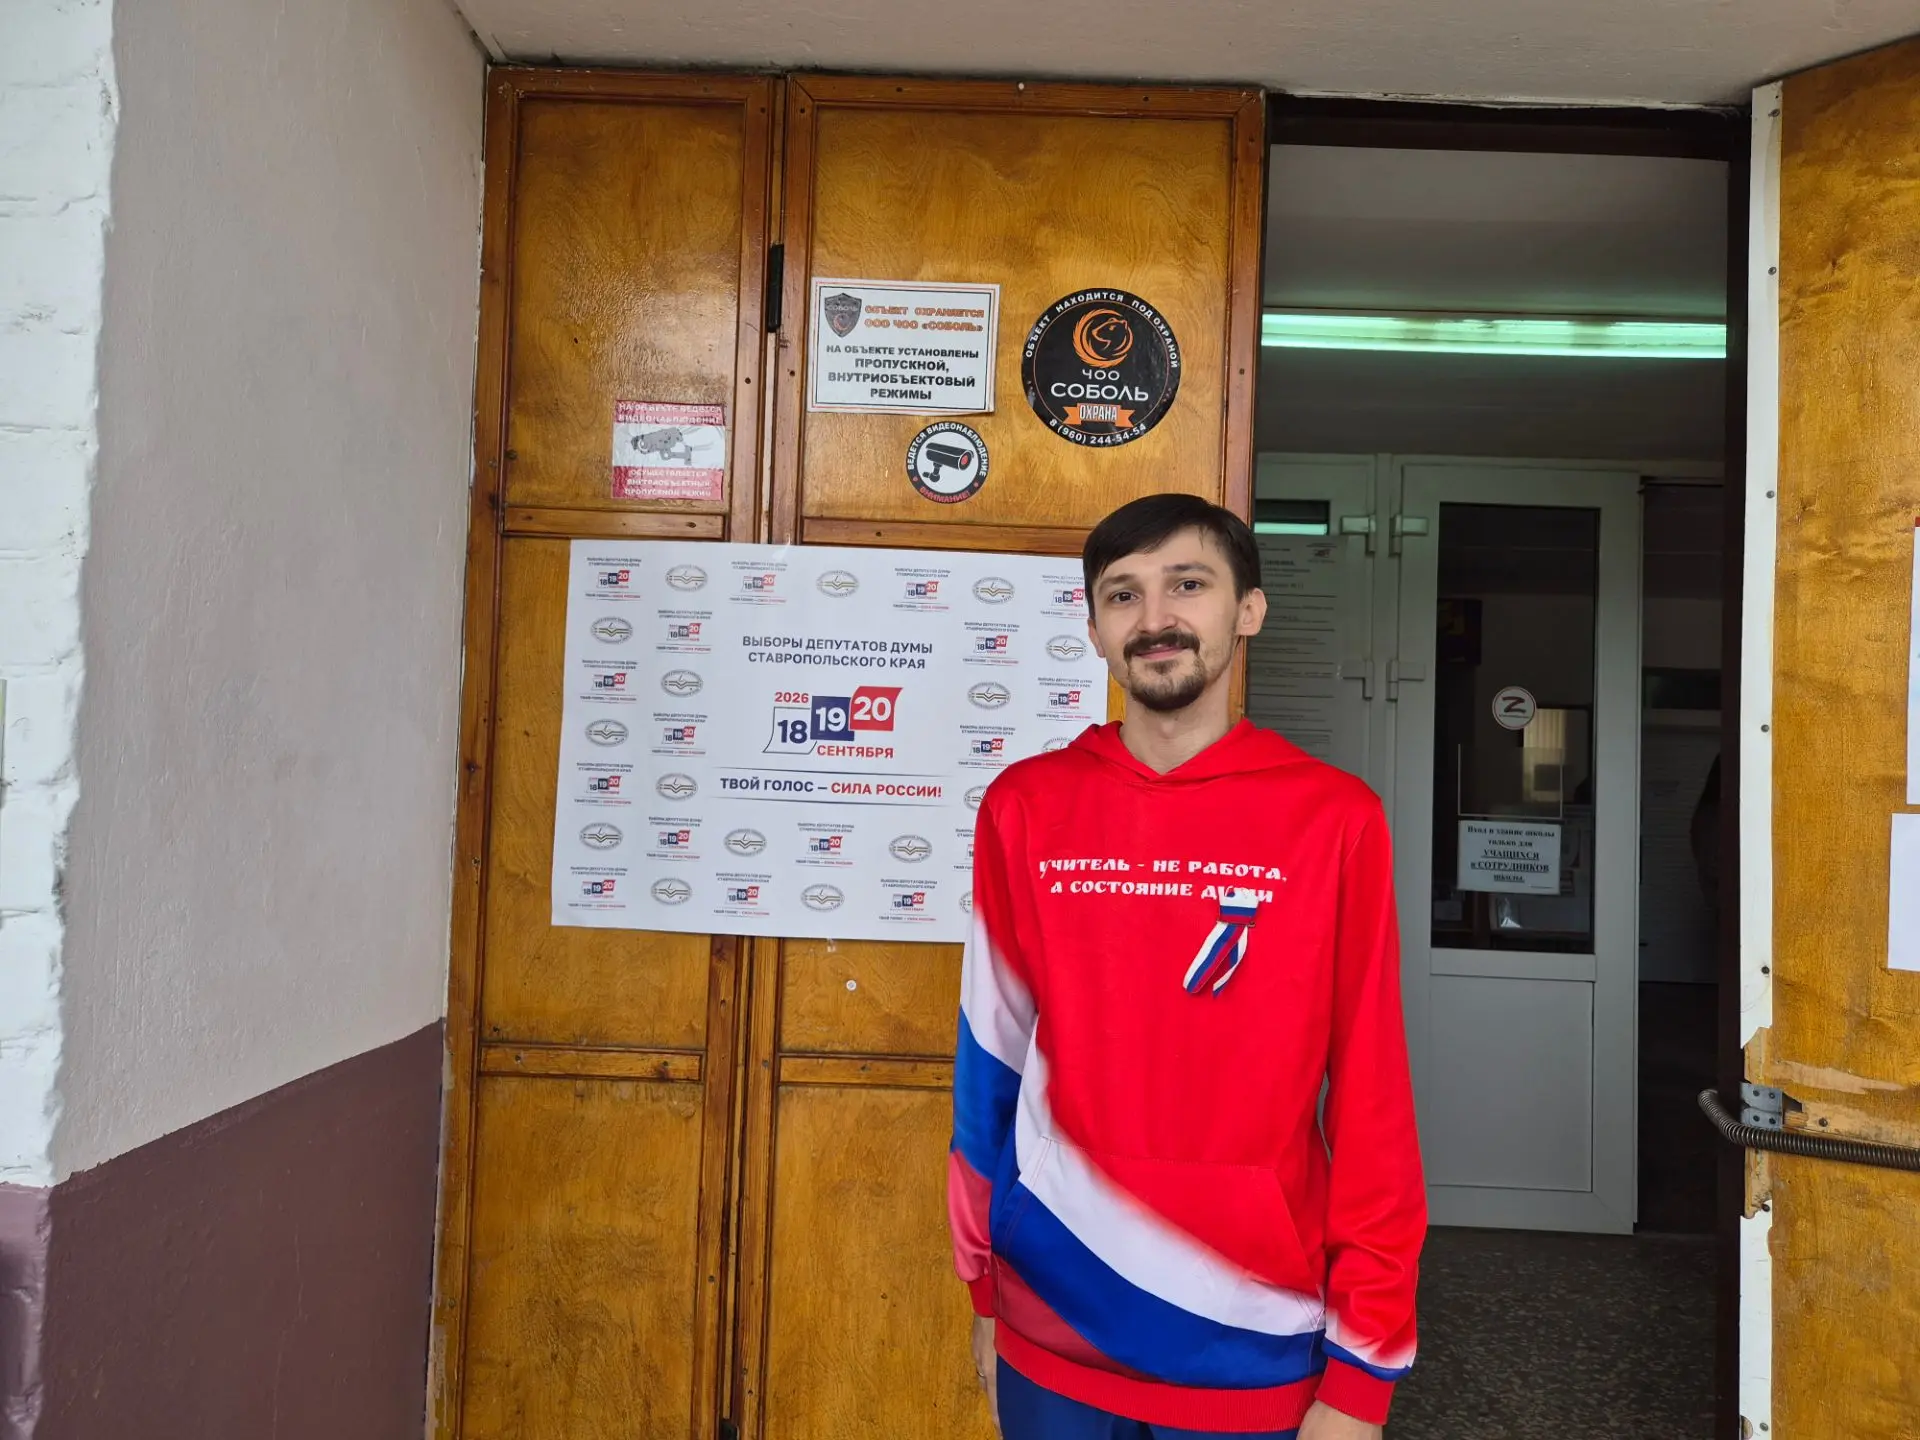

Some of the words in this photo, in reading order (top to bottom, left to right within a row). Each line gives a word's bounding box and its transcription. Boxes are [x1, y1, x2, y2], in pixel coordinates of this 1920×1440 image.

[865, 305, 908, 315] ОБЪЕКТ
[914, 307, 984, 318] ОХРАНЯЕТСЯ
[864, 319, 890, 328] ООО
[894, 320, 918, 329] ЧОО
[922, 322, 984, 332] «СОБОЛЬ»
[1026, 314, 1051, 358] ОБЪЕКТ
[1056, 292, 1124, 313] НАХОДИТСЯ
[1132, 300, 1154, 318] ПОД
[1154, 318, 1178, 368] ОХРАНОЙ
[826, 345, 842, 353] НА
[844, 346, 894, 355] ОБЪЕКТЕ
[898, 348, 979, 358] УСТАНОВЛЕНЫ
[855, 358, 950, 373] ПРОПУСКНОЙ,
[828, 372, 975, 387] ВНУТРИОБЪЕКТОВЫЙ
[1082, 369, 1120, 380] ЧОО
[870, 388, 932, 400] РЕЖИМЫ
[1051, 382, 1149, 402] СОБОЛЬ
[1080, 405, 1118, 421] ОХРАНА
[1050, 418, 1057, 427] 8
[1058, 425, 1086, 444] (960)
[1090, 422, 1146, 444] 244-54-54
[908, 433, 926, 470] ВЕДЕТСЯ
[926, 422, 988, 477] ВИДЕОНАБЛЮДЕНИЕ
[742, 636, 802, 648] ВЫБОРЫ
[806, 638, 888, 652] ДЕПУТАТОВ
[890, 642, 932, 654] ДУМЫ
[748, 652, 886, 667] СТАВРОПОЛЬСКОГО
[890, 658, 926, 668] КРАЯ
[774, 692, 809, 703] 2026
[1502, 696, 1526, 713] Z
[778, 720, 808, 744] 18
[816, 707, 846, 732] 19
[854, 696, 892, 722] 20
[817, 745, 894, 758] СЕНТЯБРЯ
[720, 777, 760, 790] ТВОЙ
[764, 780, 814, 792] ГОЛОС
[831, 783, 872, 794] СИЛА
[876, 784, 942, 798] РОССИИ!
[1484, 849, 1539, 860] УЧАЩИХСЯ
[1040, 859, 1130, 878] УЧИТЕЛЬ
[1153, 860, 1180, 873] НЕ
[1188, 860, 1288, 882] РАБОТА,
[1478, 862, 1550, 872] СОТРУДНИКОВ
[1070, 880, 1193, 896] СОСТОЯНИЕ
[1200, 884, 1273, 903] ДУИ
